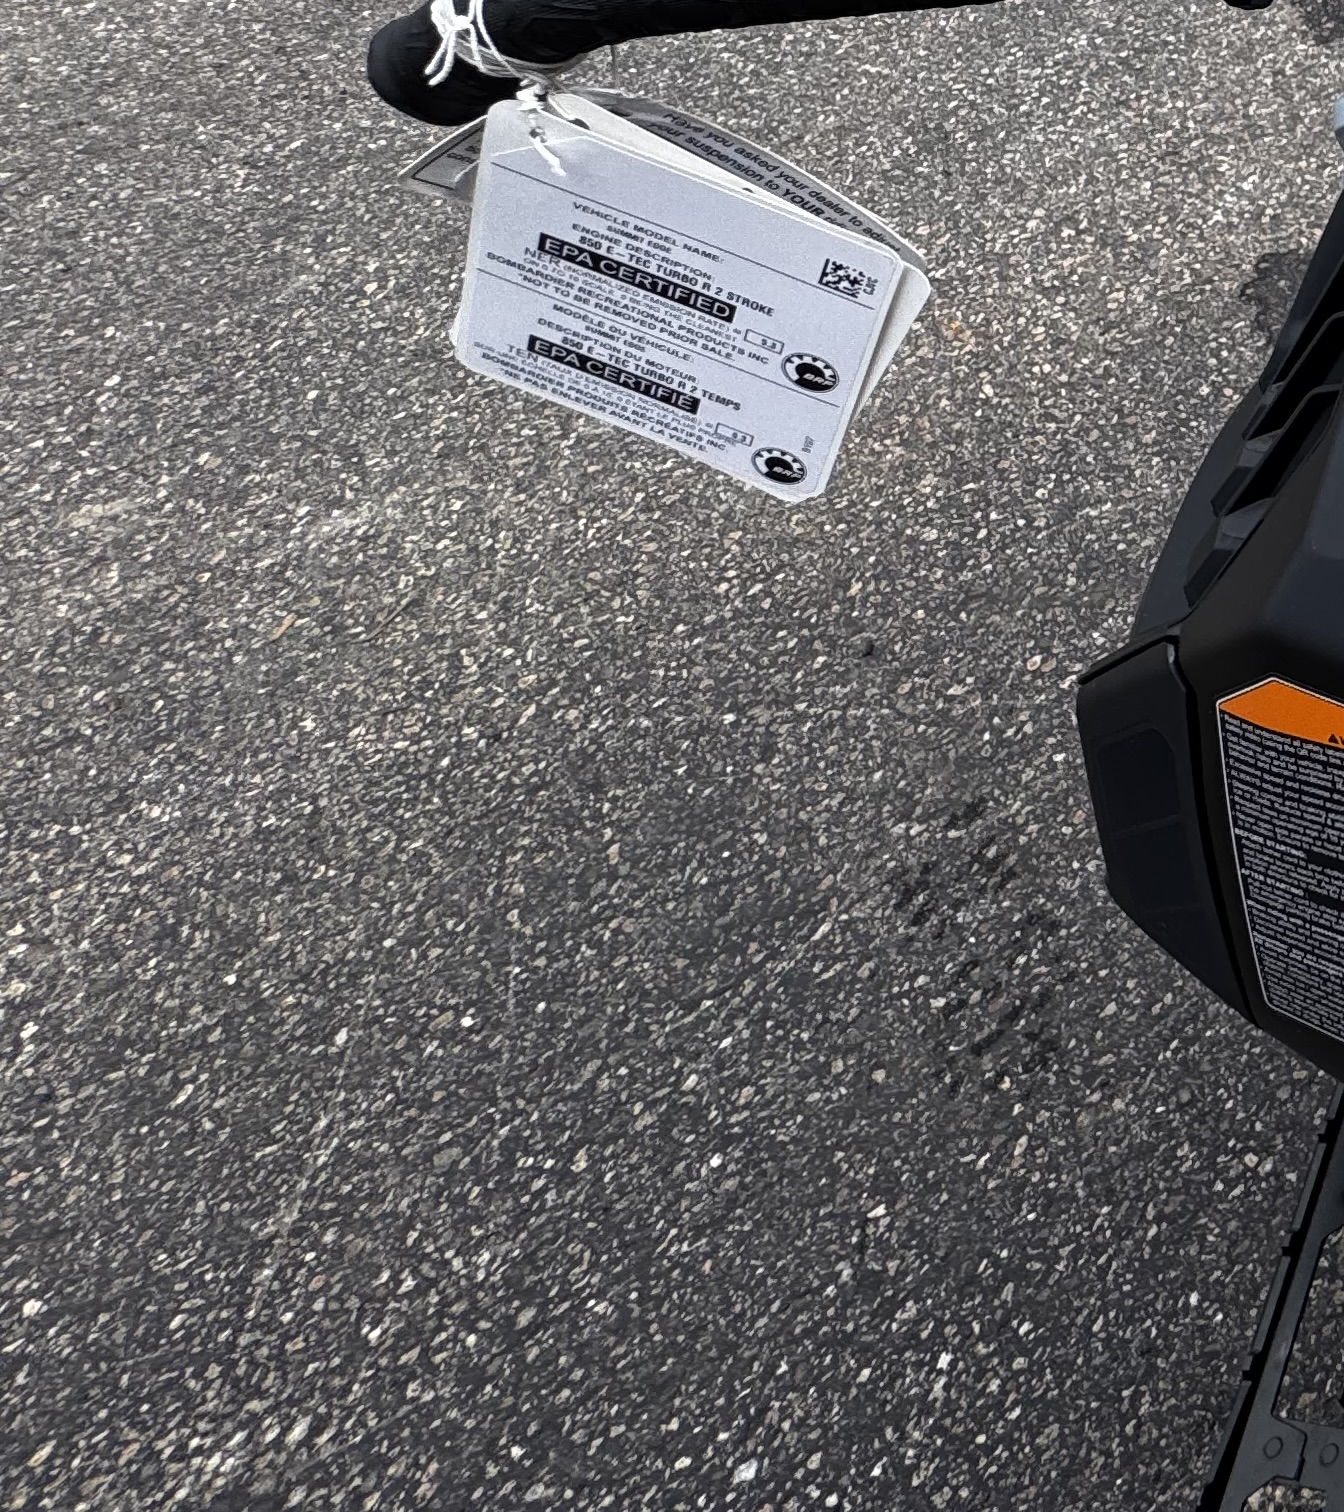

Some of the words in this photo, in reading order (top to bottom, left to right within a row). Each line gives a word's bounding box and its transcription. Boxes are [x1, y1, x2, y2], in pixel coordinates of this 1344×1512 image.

[664, 112, 704, 135] Have
[707, 129, 734, 148] you
[734, 145, 780, 173] asked
[776, 167, 811, 192] your
[808, 189, 851, 219] dealer
[851, 215, 864, 228] to
[685, 136, 765, 183] suspension
[763, 179, 780, 191] to
[779, 188, 826, 218] YOUR
[571, 222, 622, 247] ENGINE
[572, 201, 629, 228] VEHICLE
[632, 224, 679, 247] MODEL
[524, 246, 561, 268] NER
[544, 237, 595, 267] EPA
[598, 257, 731, 319] CERTIFIED
[578, 234, 602, 250] 850
[655, 263, 698, 287] TURBO
[701, 281, 711, 292] R
[714, 286, 722, 296] 2
[726, 291, 774, 317] STROKE
[486, 251, 574, 290] BOMBARDIER
[578, 286, 674, 328] RECREATIONAL
[677, 324, 745, 355] PRODUCTS
[553, 286, 570, 297] TO
[573, 293, 590, 306] BE
[594, 301, 656, 330] REMOVED
[659, 326, 698, 346] PRIOR
[608, 325, 627, 337] DU
[507, 344, 538, 362] TEN
[537, 317, 621, 355] DESCRIPTION
[624, 350, 641, 362] DU
[482, 352, 564, 388] BOMBARDIER
[567, 384, 628, 413] PRODUITS
[534, 339, 582, 367] EPA
[585, 357, 694, 410] CERTIFIÉ
[561, 335, 583, 350] 850
[633, 363, 674, 385] TURBO
[689, 385, 697, 394] 2
[700, 389, 741, 411] TEMPS
[801, 371, 834, 389] BRP
[524, 376, 547, 390] PAS
[550, 386, 606, 413] ENLEVER
[609, 409, 646, 428] AVANT
[649, 425, 665, 436] LA
